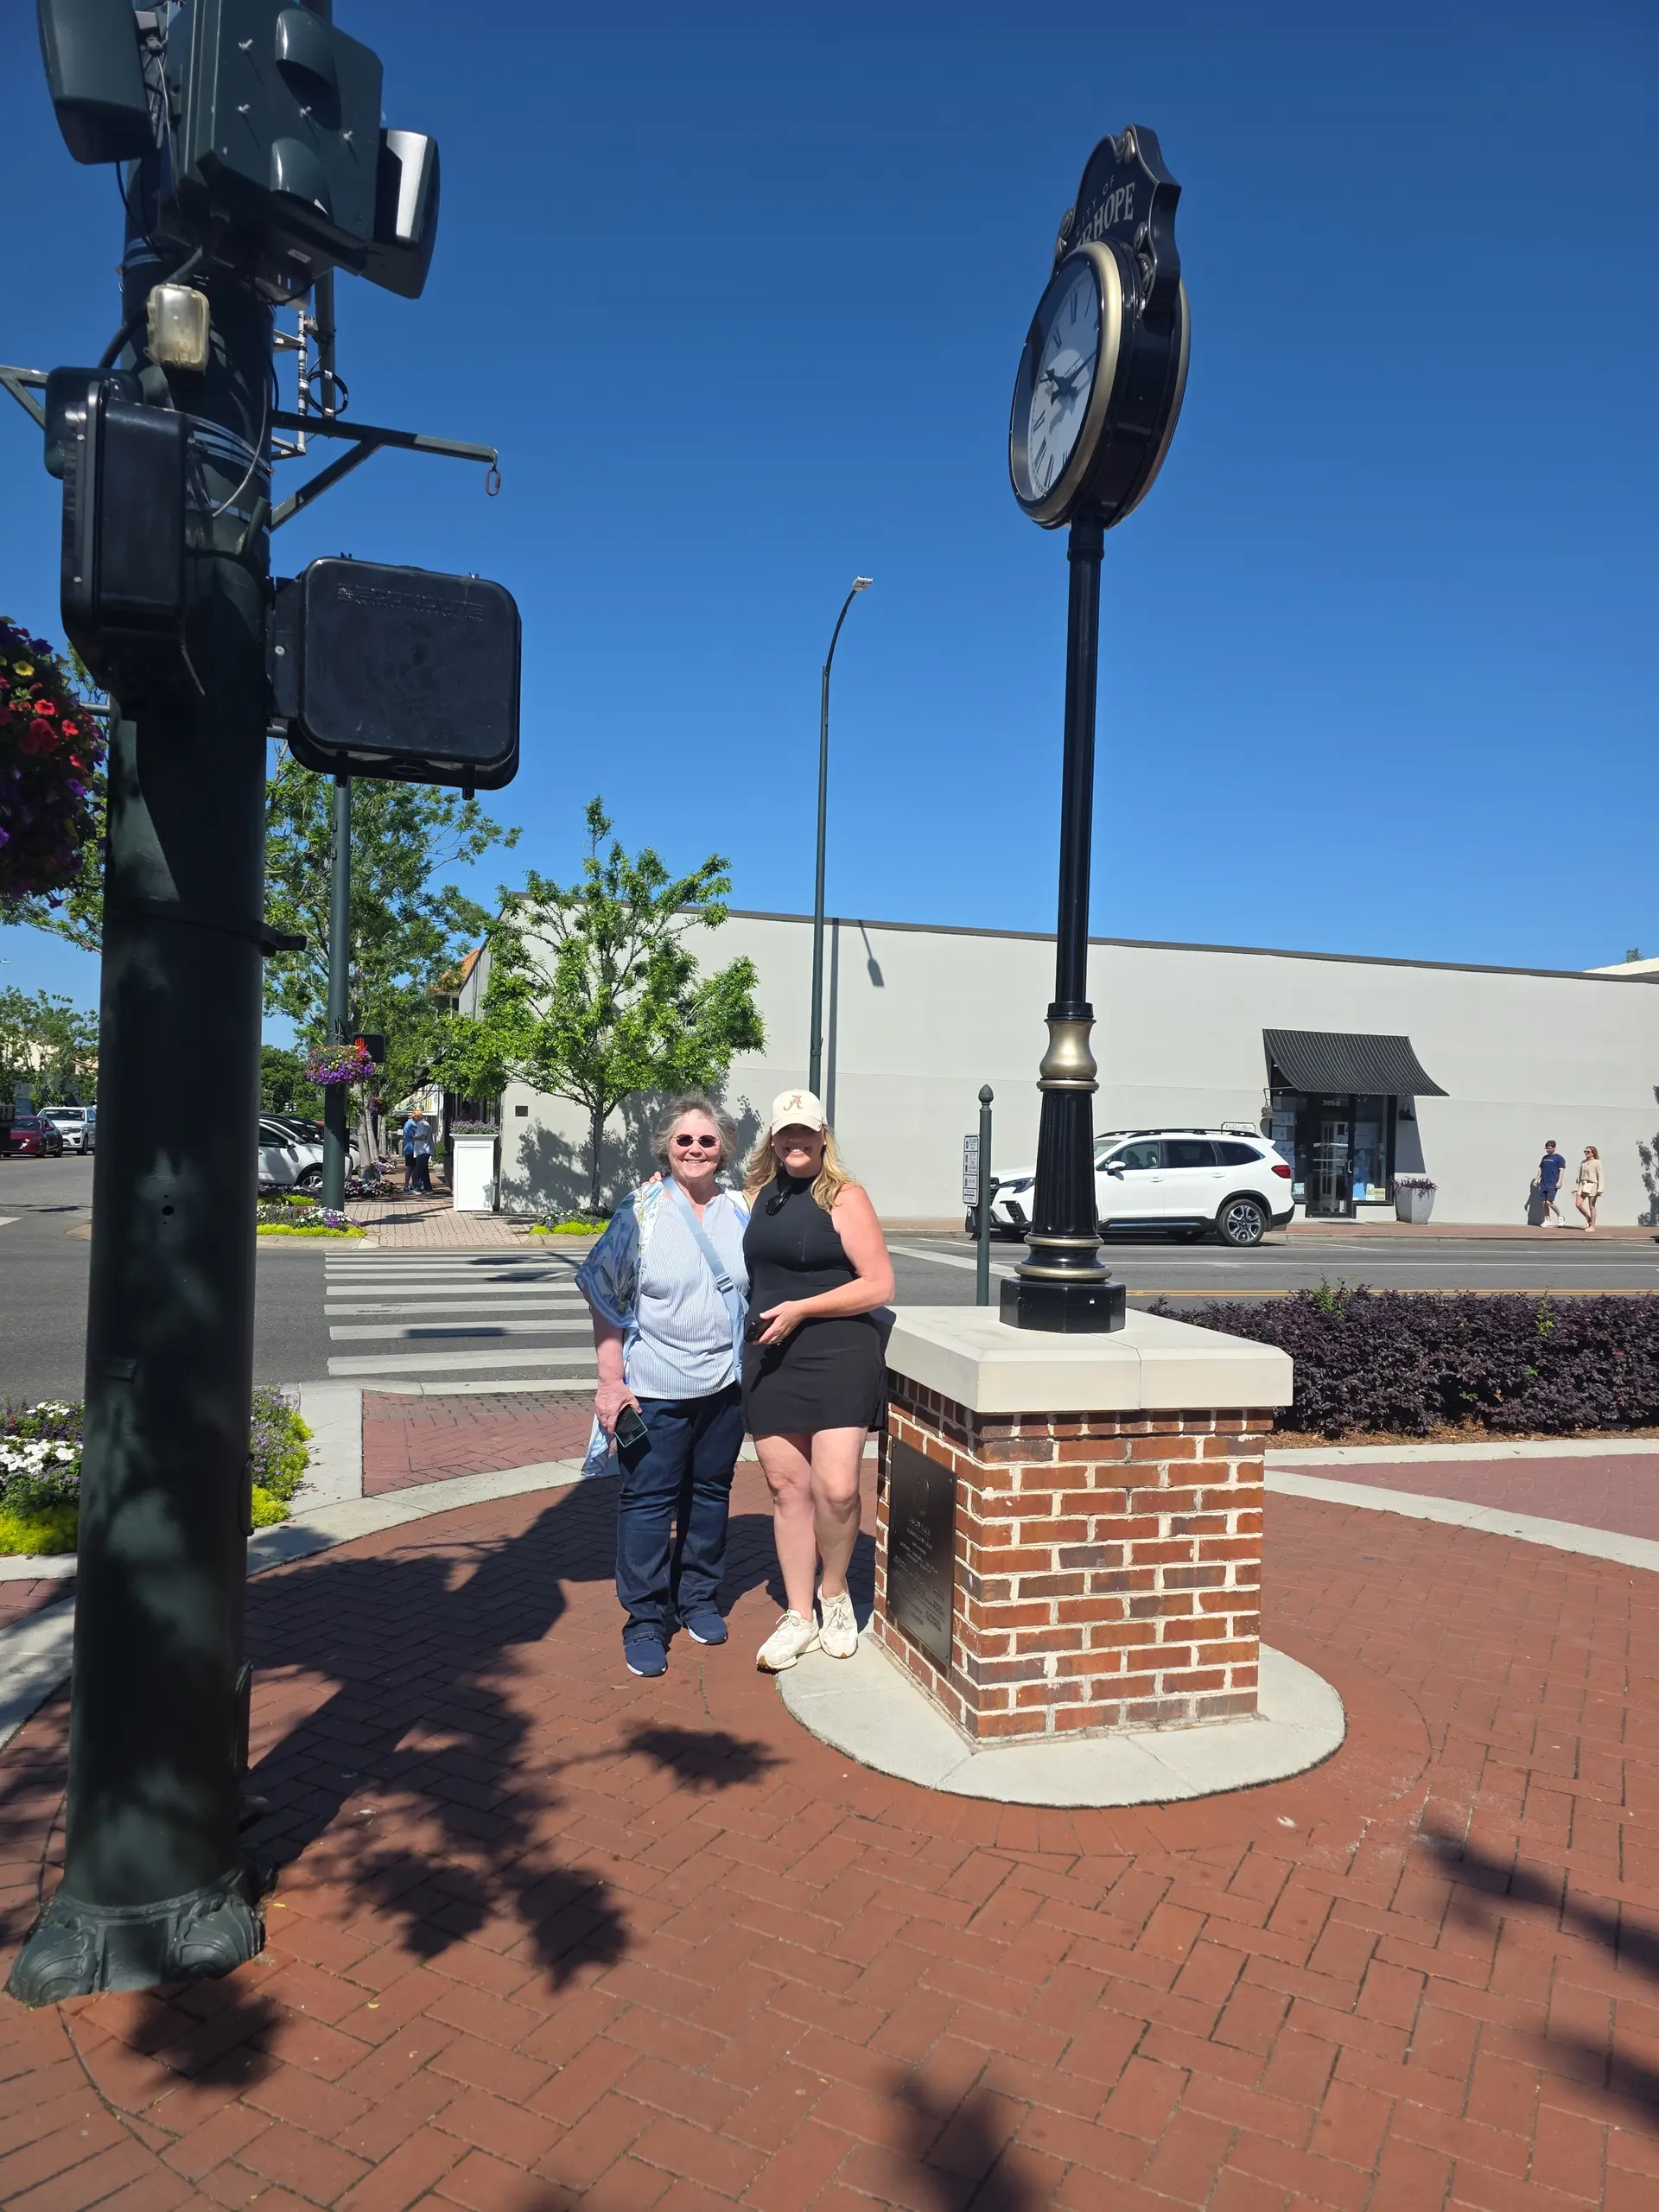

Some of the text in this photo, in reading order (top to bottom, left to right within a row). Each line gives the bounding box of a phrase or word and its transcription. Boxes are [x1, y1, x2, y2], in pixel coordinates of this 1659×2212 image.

[1076, 173, 1115, 237] CITY OF
[1077, 181, 1135, 247] RHOPE
